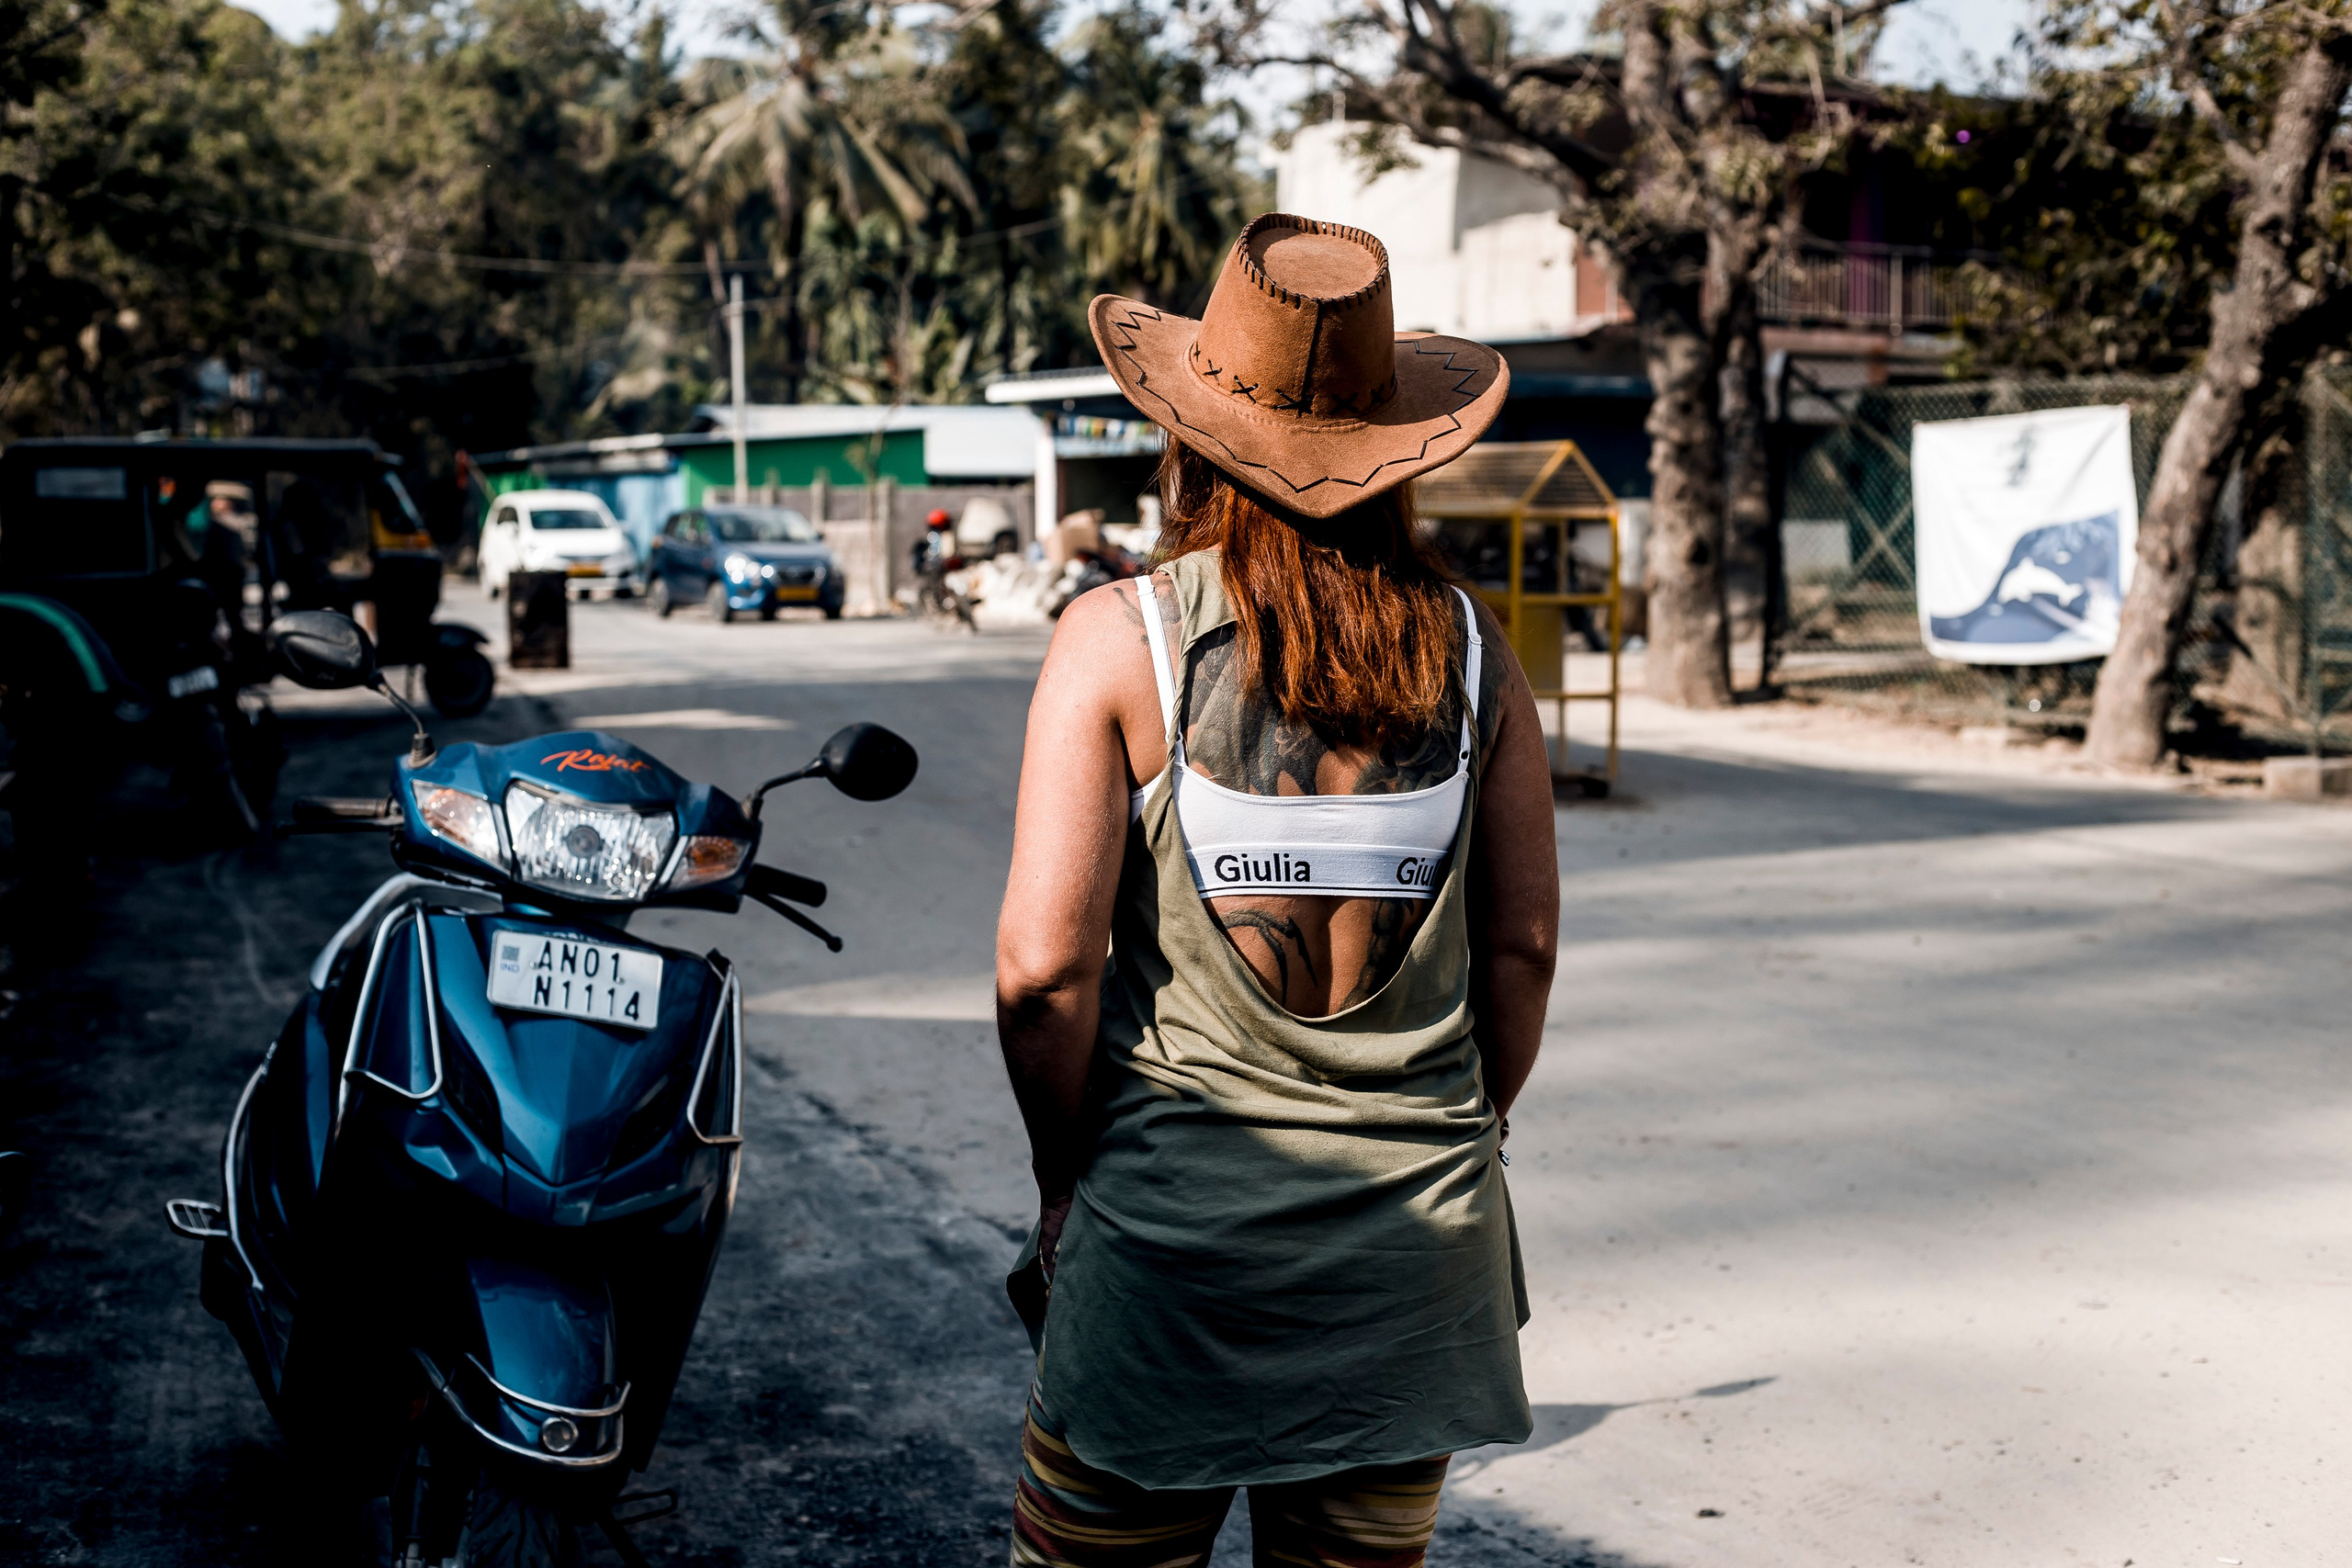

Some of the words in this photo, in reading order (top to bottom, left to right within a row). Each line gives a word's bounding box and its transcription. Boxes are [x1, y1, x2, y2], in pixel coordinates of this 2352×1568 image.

[1214, 852, 1311, 883] Giulia
[1396, 856, 1442, 887] Giul
[538, 940, 620, 982] AN01
[534, 975, 640, 1021] N1114
